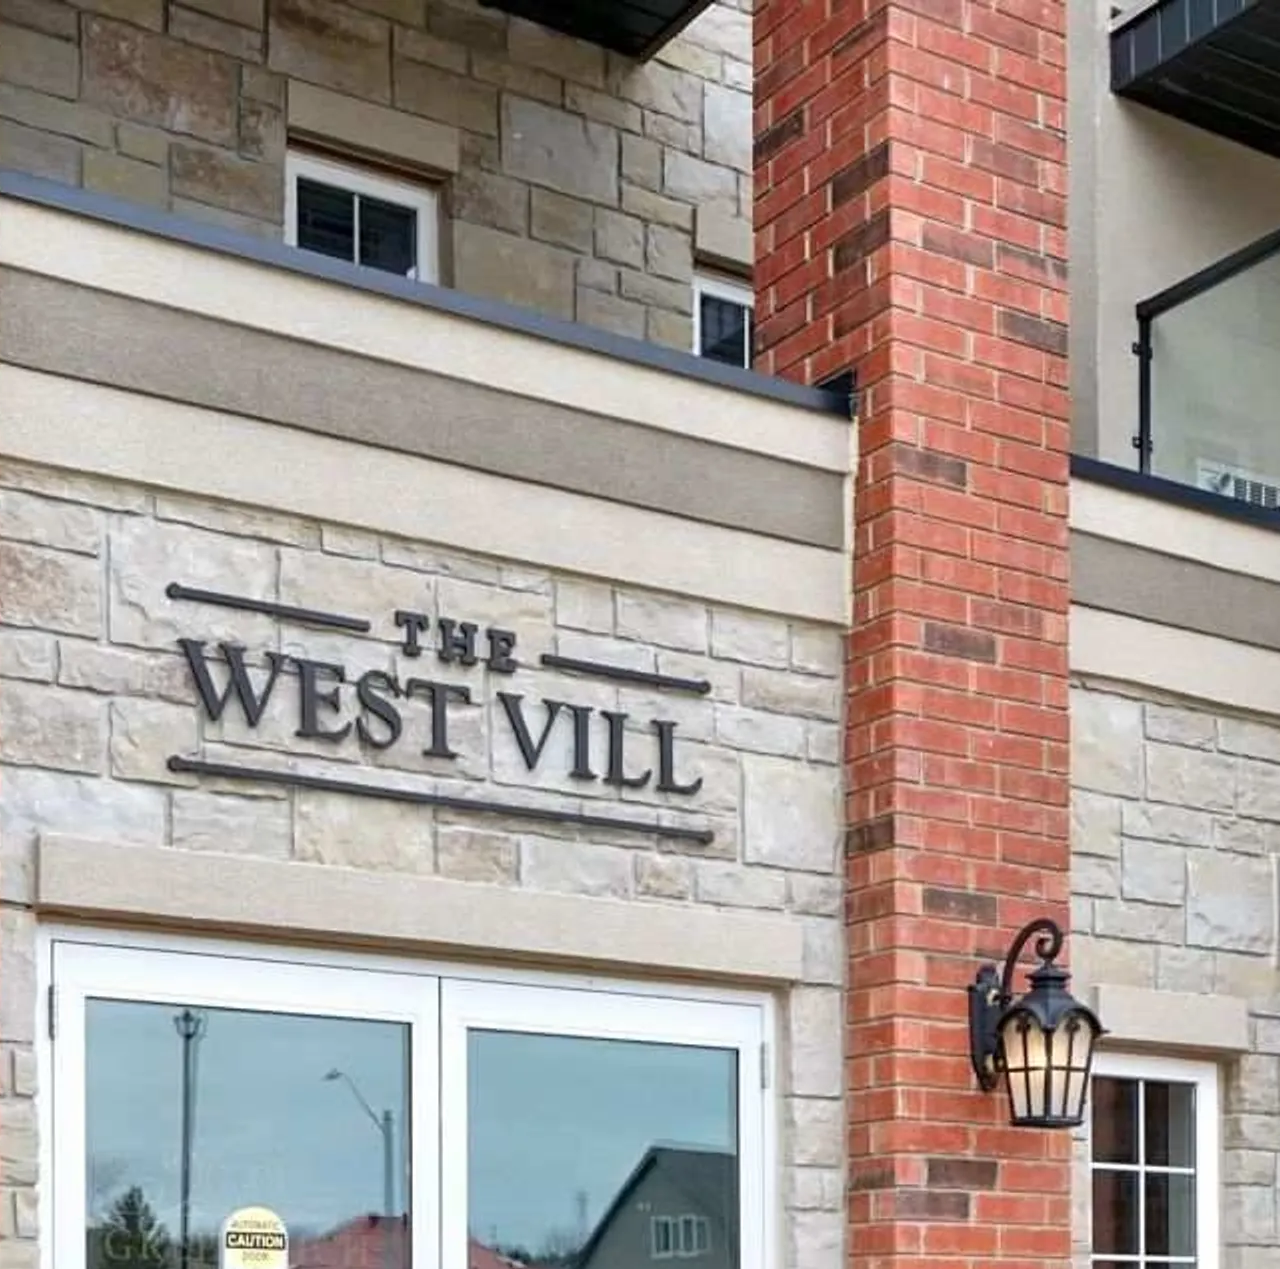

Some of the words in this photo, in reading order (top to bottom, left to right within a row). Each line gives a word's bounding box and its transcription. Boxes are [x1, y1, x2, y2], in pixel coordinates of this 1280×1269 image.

[394, 610, 517, 673] THE
[176, 637, 471, 760] WEST
[496, 691, 704, 796] VILL
[227, 1234, 284, 1248] CAUTION
